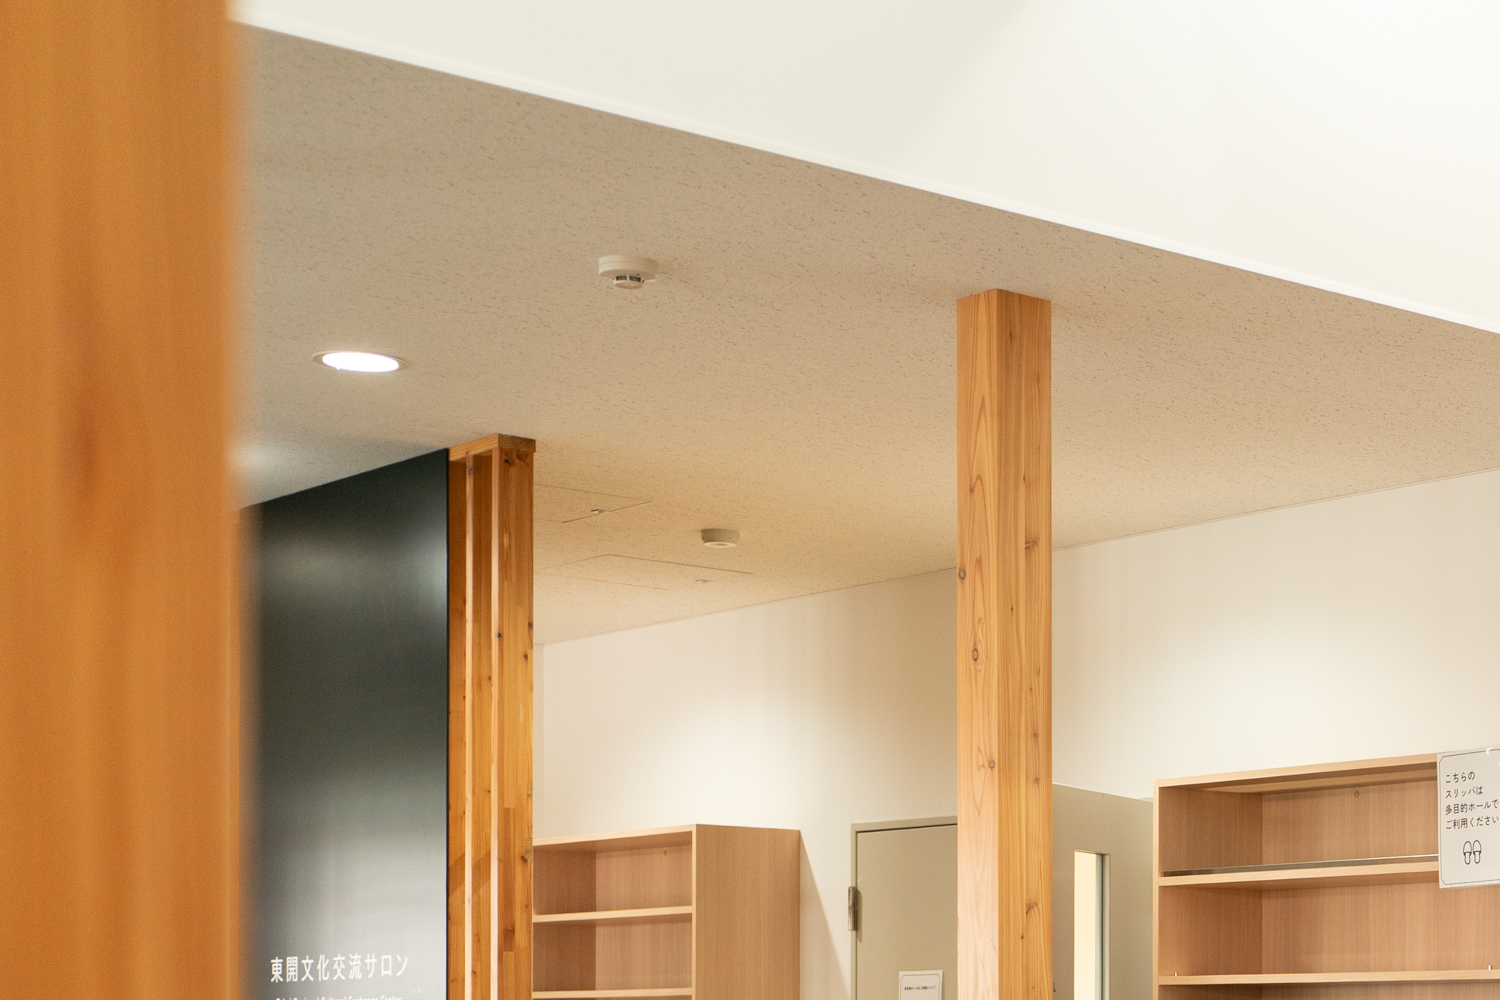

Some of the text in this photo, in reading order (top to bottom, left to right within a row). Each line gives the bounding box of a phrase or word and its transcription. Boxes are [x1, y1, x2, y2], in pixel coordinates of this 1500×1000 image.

[1445, 771, 1475, 784] こちらの
[1445, 786, 1483, 799] スリッパは
[1445, 799, 1499, 815] 多目的ホールで
[1445, 816, 1499, 830] ご利用ください
[270, 953, 408, 983] 東開文化交流サロン
